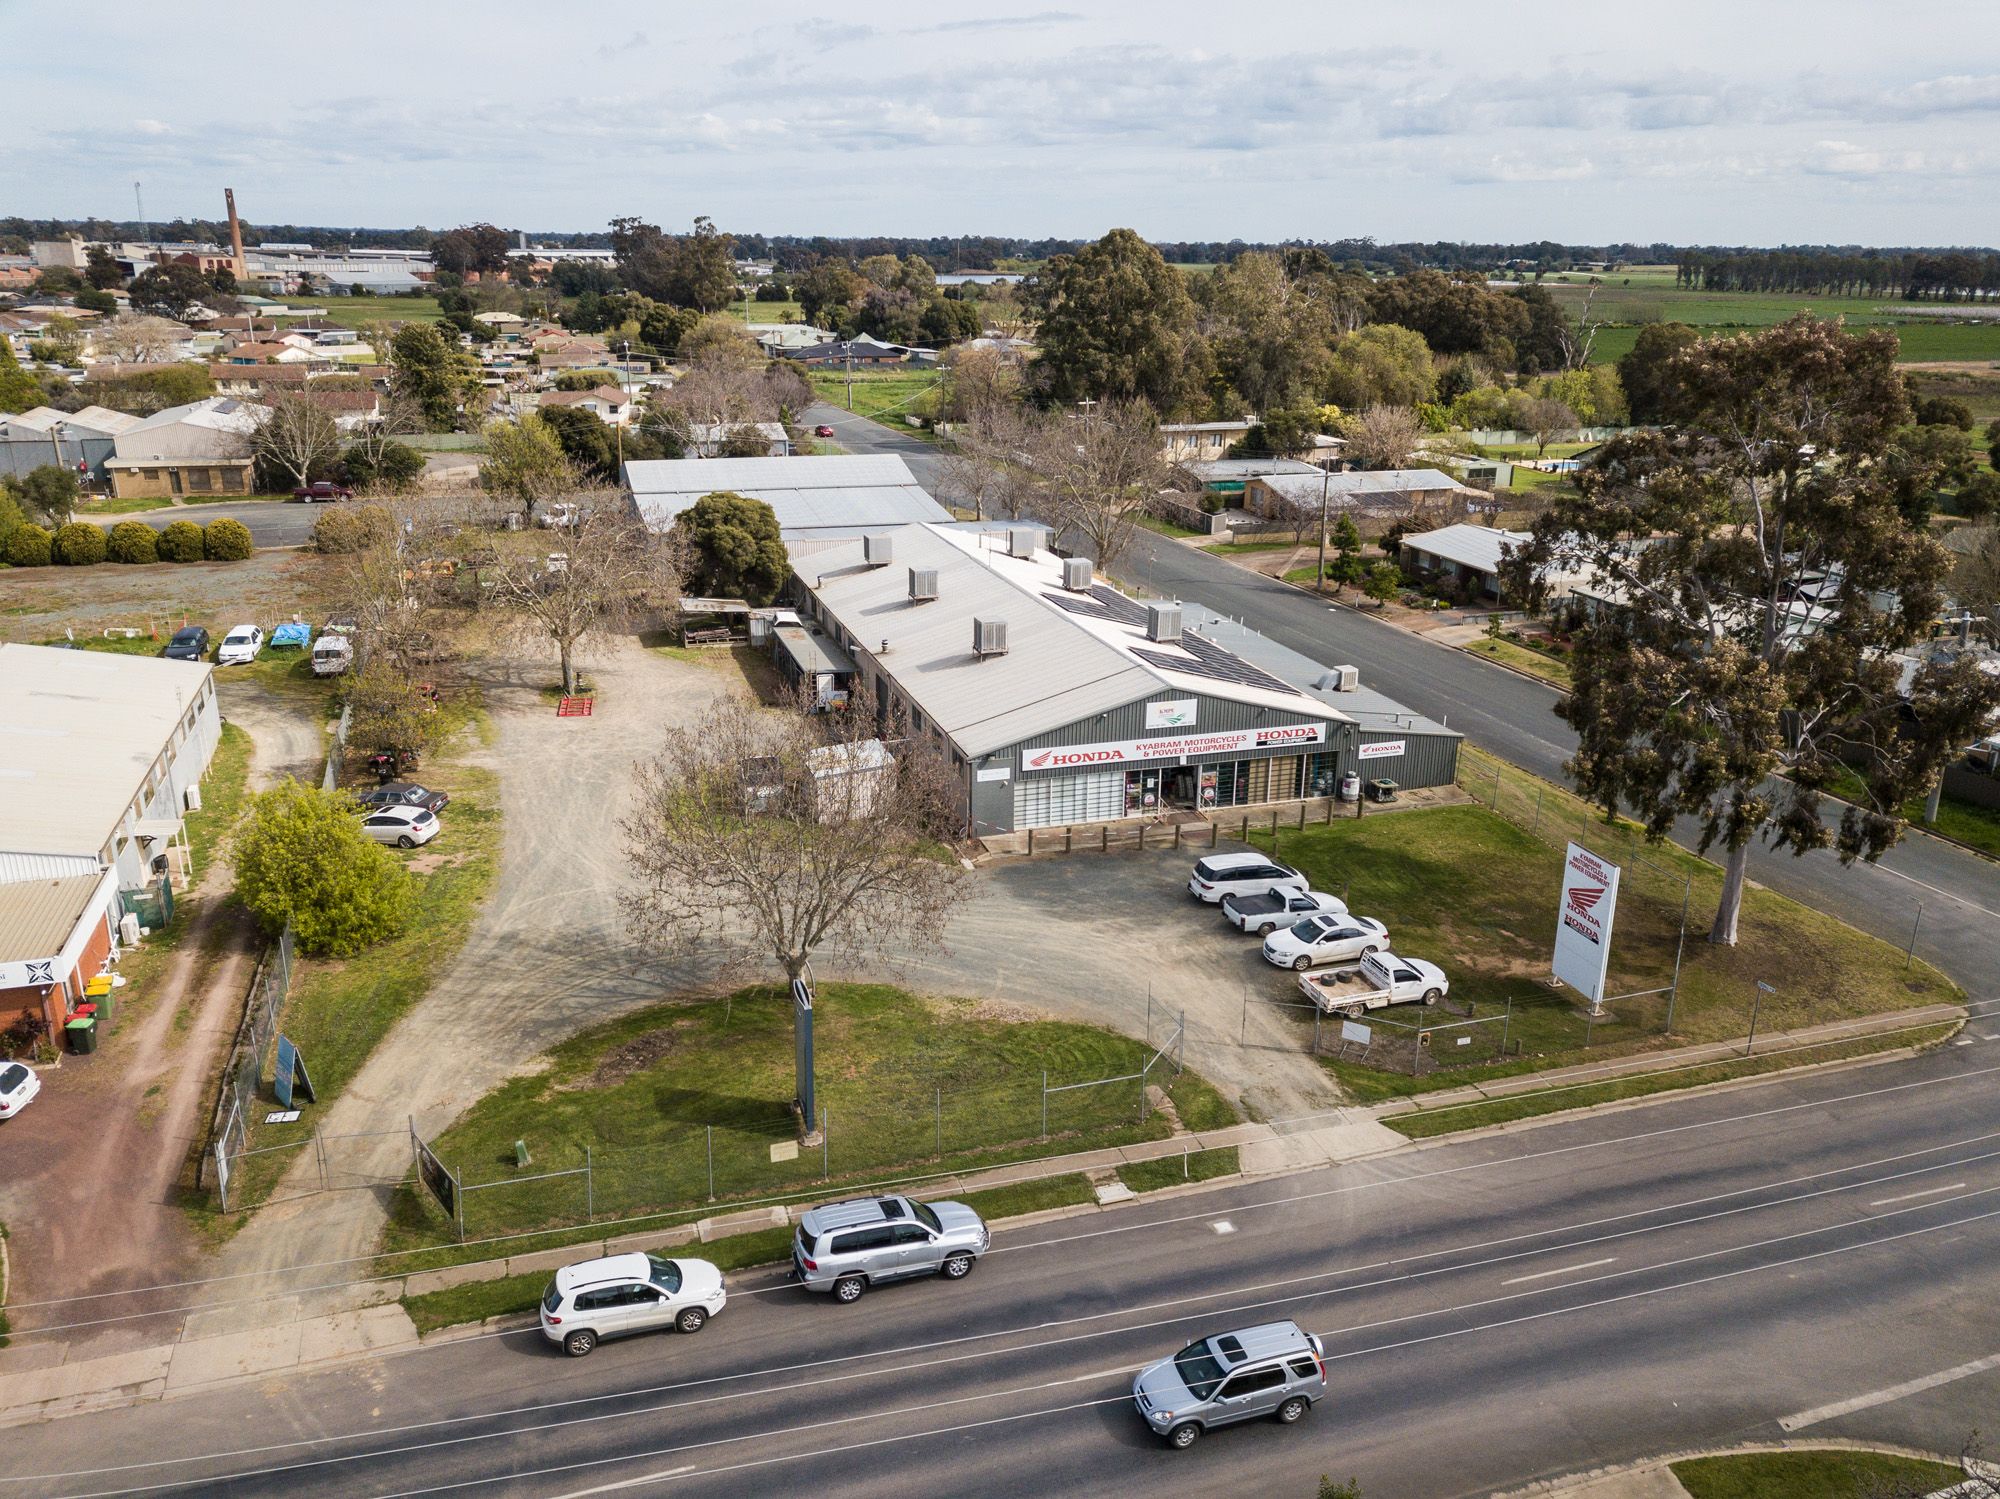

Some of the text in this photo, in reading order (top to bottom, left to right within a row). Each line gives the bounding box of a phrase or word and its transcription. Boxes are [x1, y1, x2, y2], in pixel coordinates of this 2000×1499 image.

[1136, 735, 1247, 751] KYABRAM MOTORCYCLES
[1256, 728, 1318, 740] HONDA
[1053, 750, 1125, 765] HONDA
[1152, 748, 1185, 757] POWER
[1188, 743, 1239, 753] EQUIPMENT
[1569, 860, 1610, 888] POWER EQUIPMENT
[1573, 856, 1604, 877] MOTORCYCLES
[1567, 902, 1601, 928] HONDA
[1565, 914, 1599, 940] HONDA
